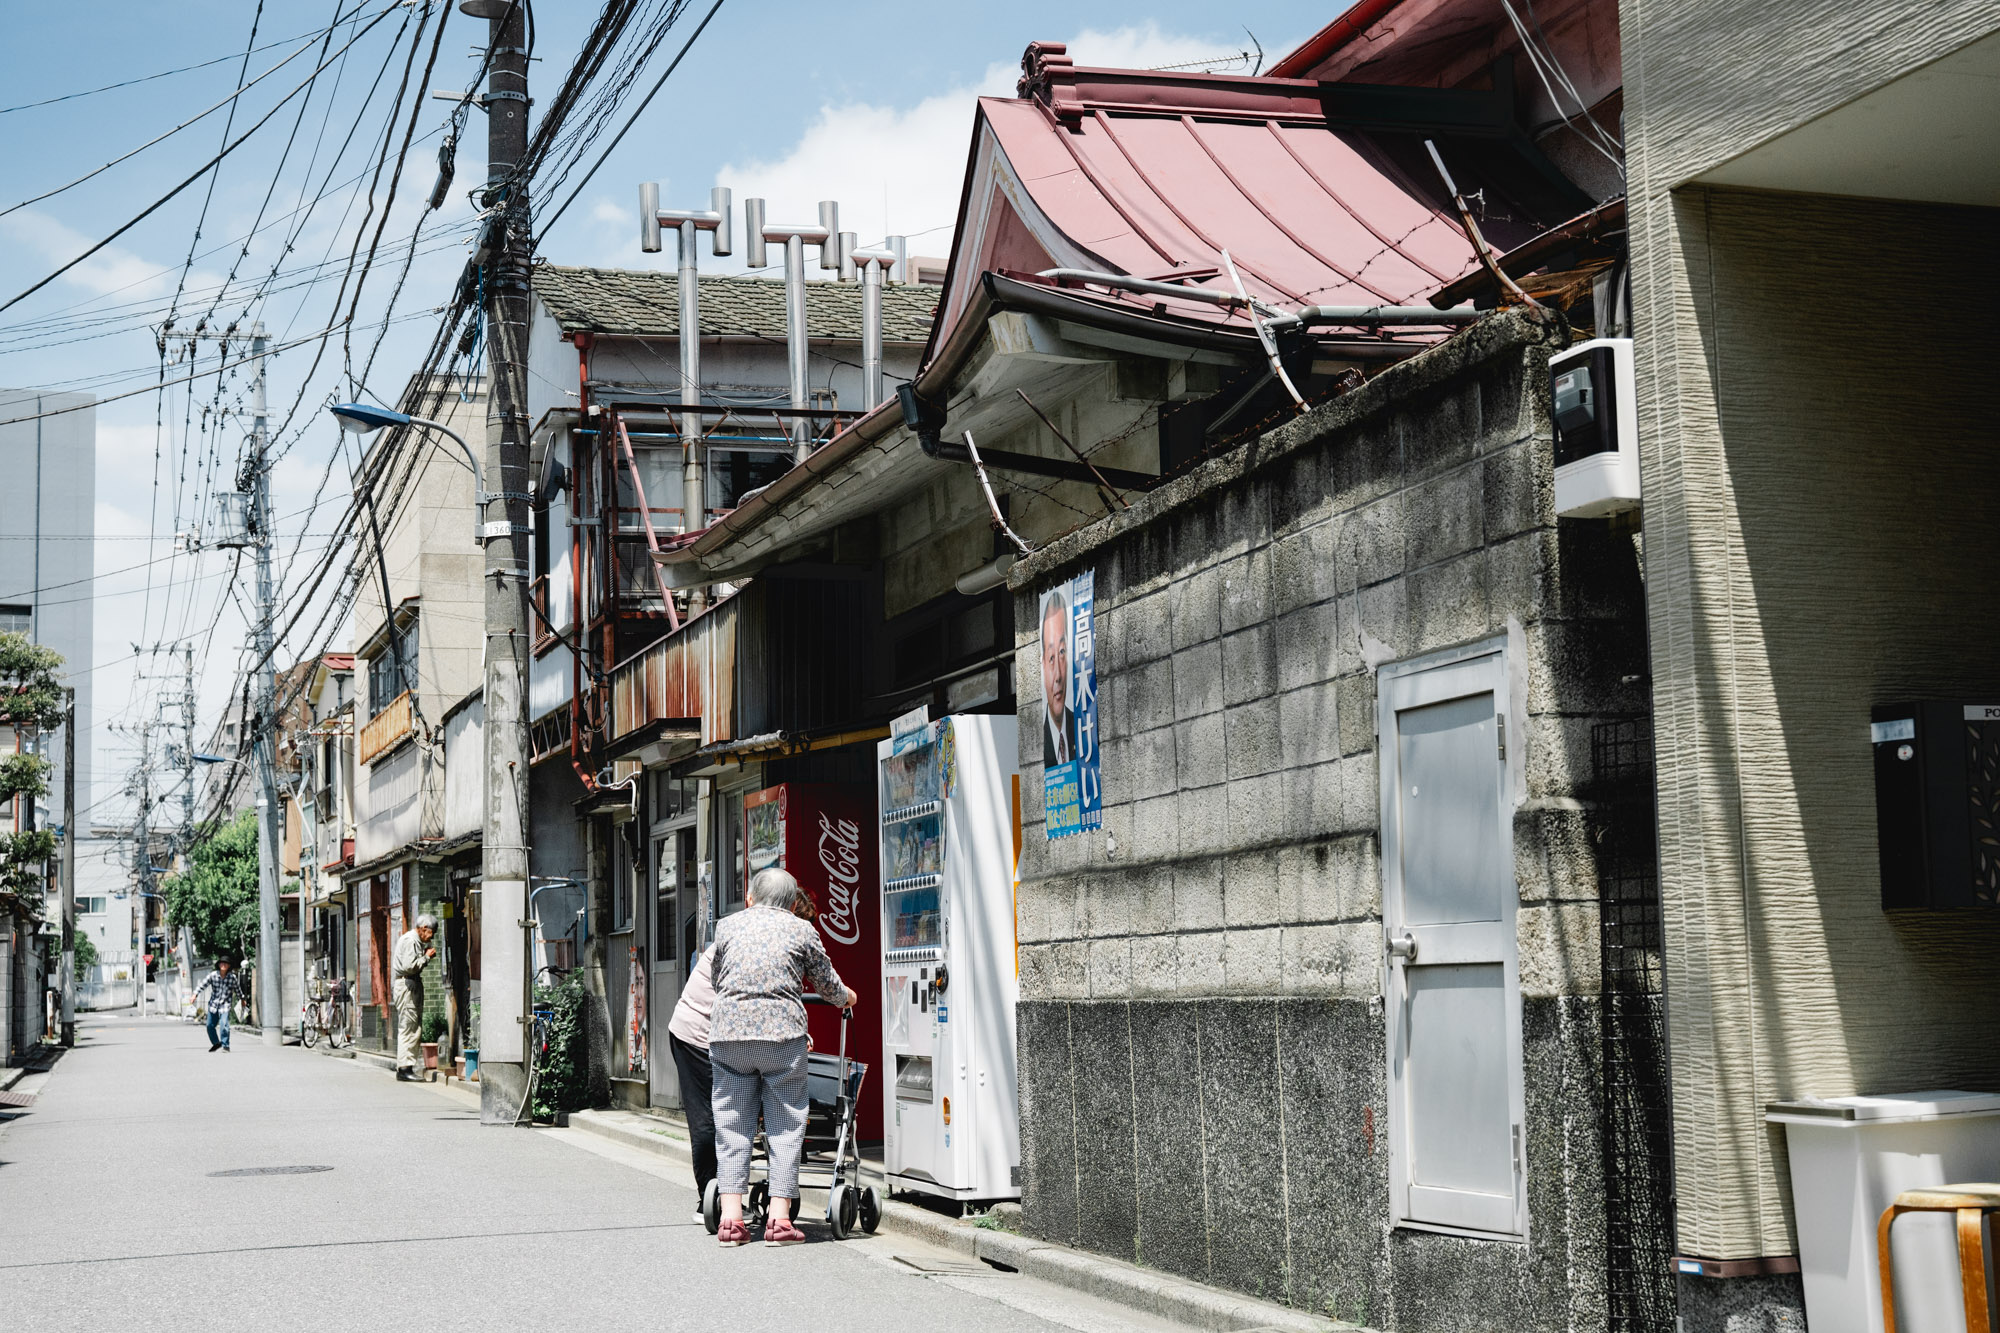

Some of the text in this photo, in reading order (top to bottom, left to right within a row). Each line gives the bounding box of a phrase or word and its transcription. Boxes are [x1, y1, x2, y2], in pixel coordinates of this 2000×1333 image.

[1074, 607, 1098, 809] 高木けい
[818, 810, 860, 945] Coca-Cola
